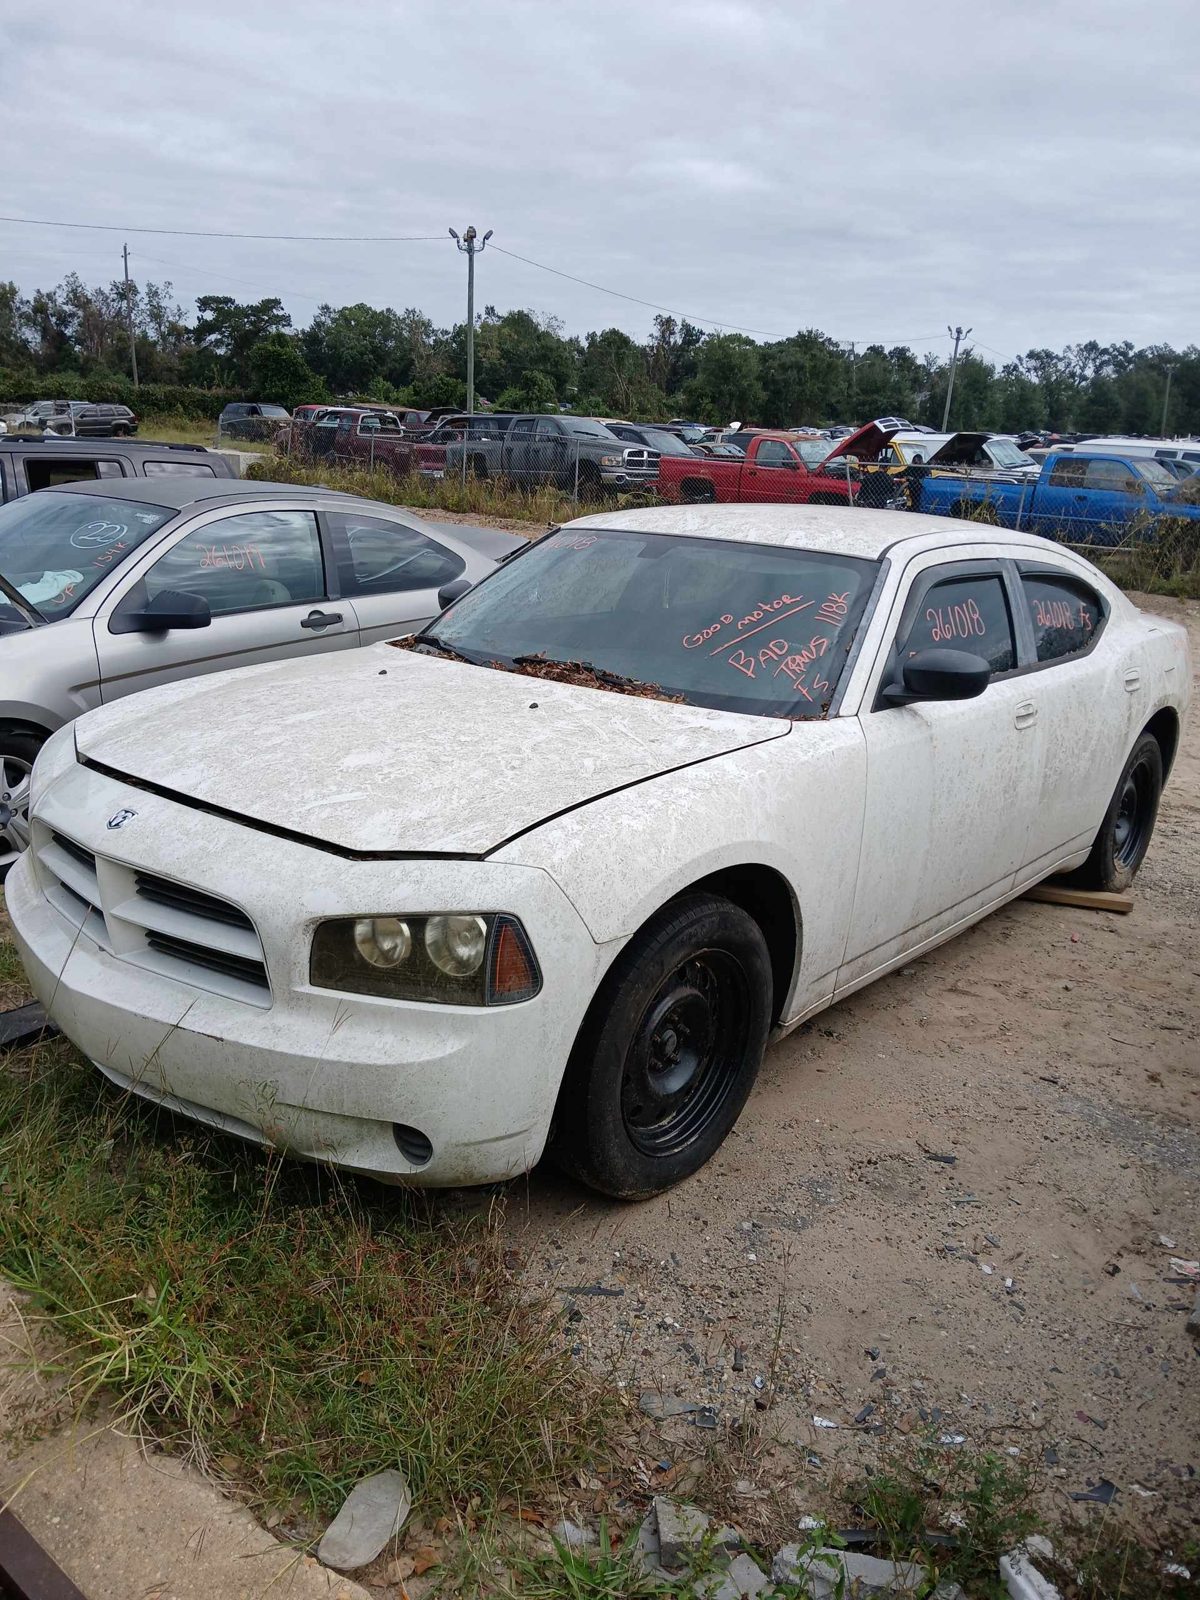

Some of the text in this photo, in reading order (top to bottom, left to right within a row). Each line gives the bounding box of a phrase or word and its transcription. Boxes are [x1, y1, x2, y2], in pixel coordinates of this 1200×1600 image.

[926, 598, 986, 642] 261018
[1032, 600, 1074, 631] 261018
[728, 639, 789, 679] BAD
